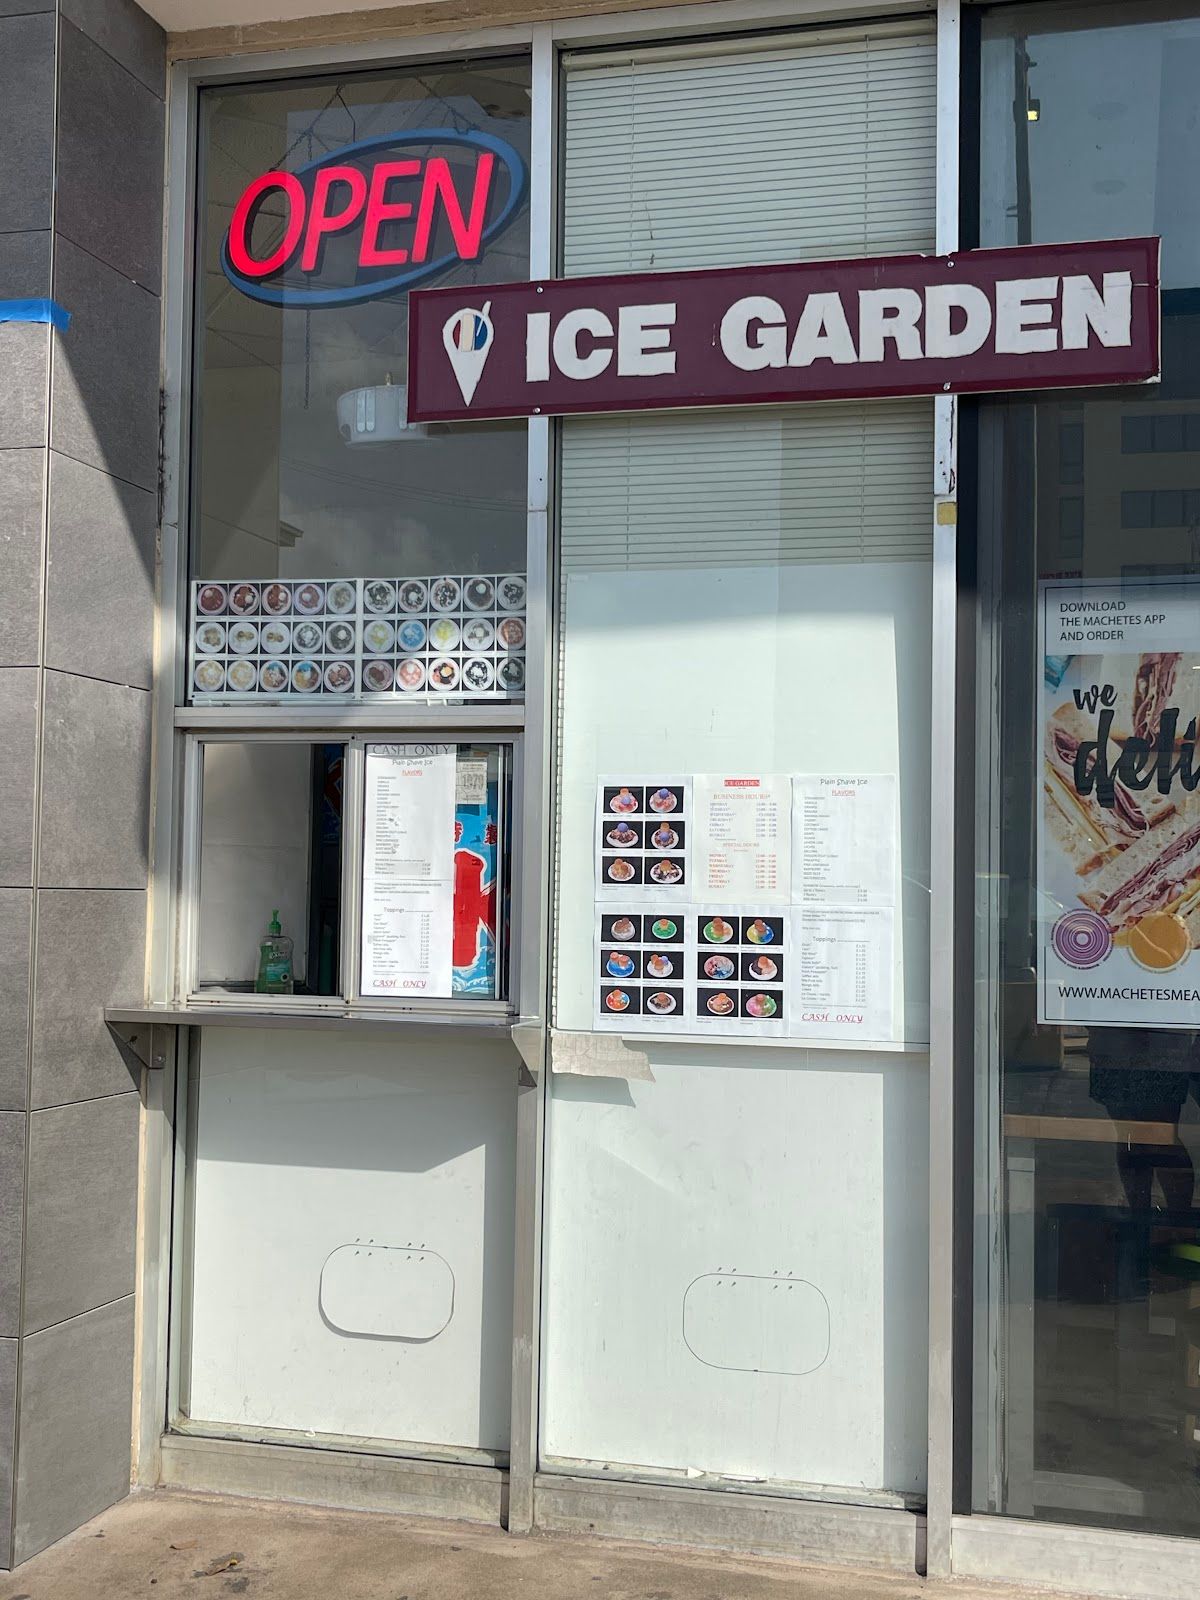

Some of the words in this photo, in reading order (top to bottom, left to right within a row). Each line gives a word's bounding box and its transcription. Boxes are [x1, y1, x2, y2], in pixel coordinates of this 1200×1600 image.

[227, 153, 494, 277] OPEN
[525, 303, 678, 382] ICE
[719, 270, 1133, 372] GARDEN
[1060, 601, 1126, 613] DOWNLOAD
[1060, 617, 1081, 627] THE
[1083, 615, 1142, 626] MACHETES
[1144, 614, 1166, 625] APP
[1059, 631, 1084, 641] AND
[1086, 630, 1124, 641] ORDER
[1073, 684, 1118, 714] we
[372, 744, 406, 755] CASH
[414, 744, 450, 756] ONLY
[836, 778, 856, 786] Shave
[857, 778, 868, 786] Ice
[372, 979, 397, 988] CASH
[402, 980, 427, 989] ONLY
[801, 1012, 830, 1022] CASH
[835, 1014, 863, 1024] ONLY
